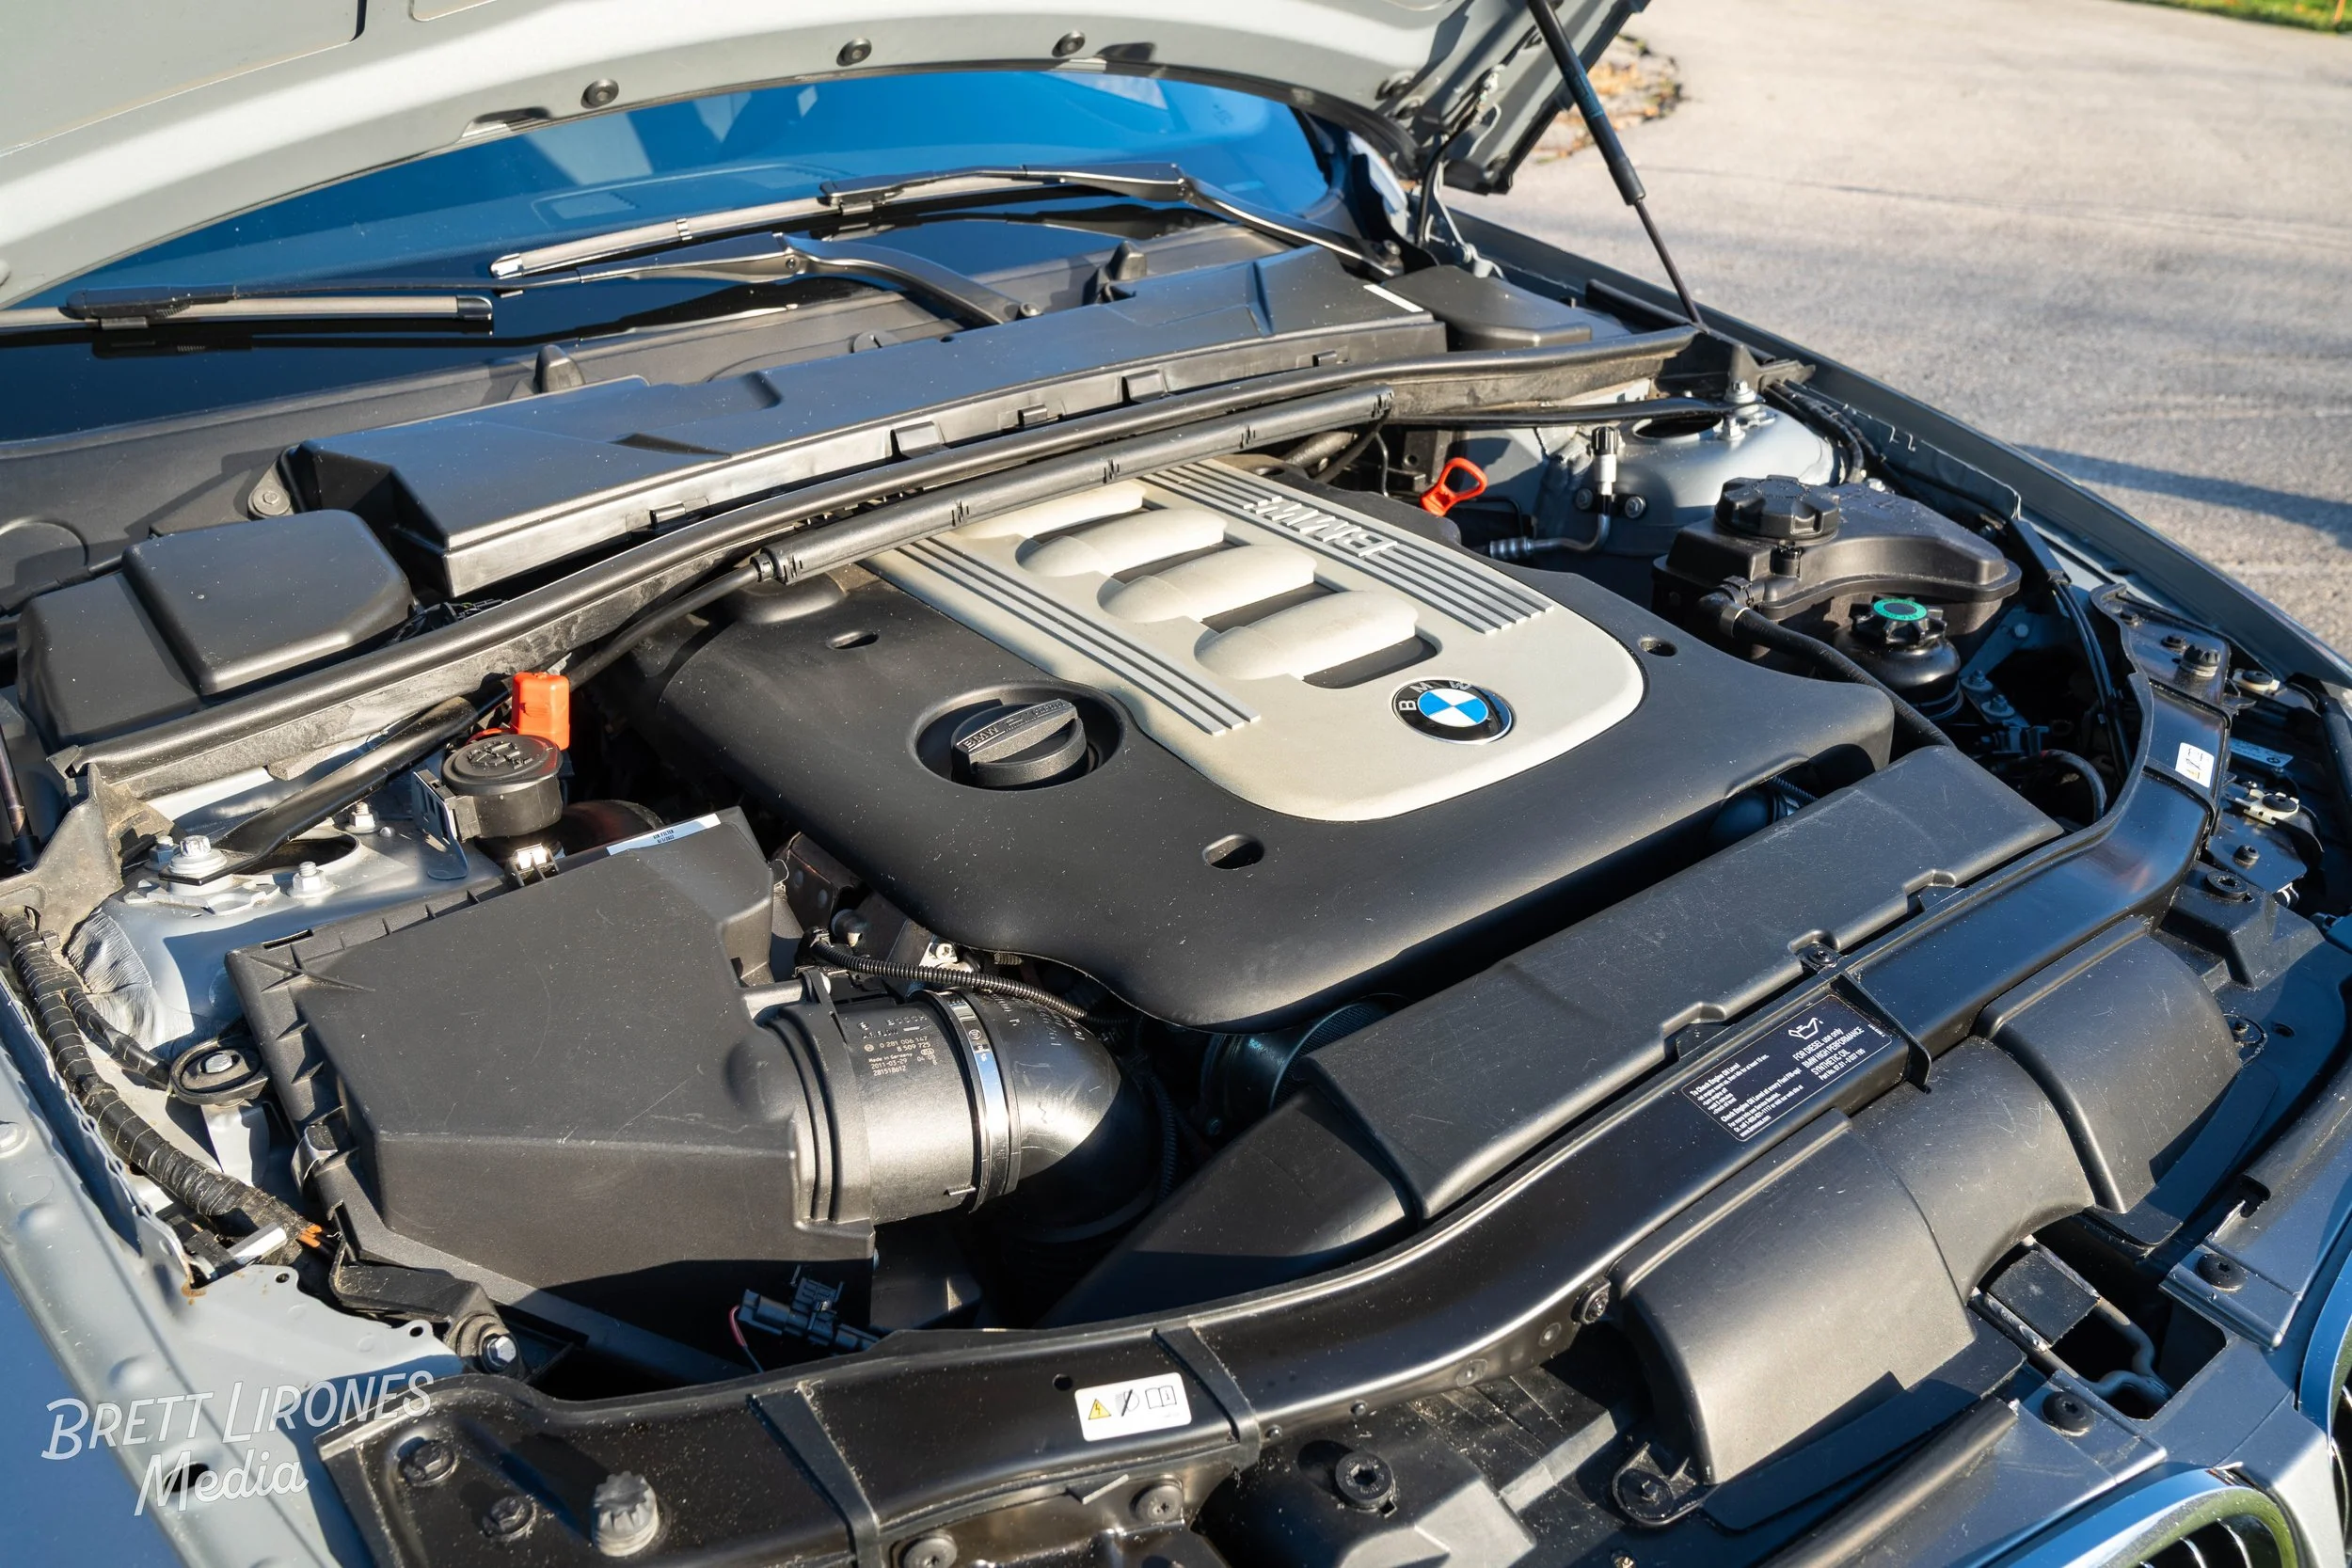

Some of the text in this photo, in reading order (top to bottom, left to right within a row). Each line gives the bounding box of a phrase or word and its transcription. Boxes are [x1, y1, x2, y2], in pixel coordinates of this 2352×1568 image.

[1249, 502, 1398, 557] BMW
[1398, 680, 1471, 711] BMW
[963, 725, 999, 749] BMW
[876, 1028, 898, 1037] FLOW
[885, 1016, 928, 1026] BOSCH
[1792, 1050, 1806, 1060] FOR
[1803, 1039, 1823, 1053] DIESEL
[1829, 1027, 1844, 1037] only
[1802, 1056, 1818, 1068] BMW
[1814, 1048, 1830, 1059] HIGH
[1826, 1026, 1864, 1052] PERFORMANCE
[871, 1058, 907, 1069] 2011-03-29
[1810, 1048, 1850, 1074] SYNTHETIC OIL
[1695, 1082, 1710, 1091] Check
[1708, 1073, 1724, 1085] Engine
[1726, 1063, 1740, 1071] Level
[1702, 1088, 1715, 1097] engine
[1720, 1111, 1735, 1121] Check
[1732, 1101, 1750, 1114] Engine
[1752, 1091, 1765, 1100] Level
[1768, 1082, 1781, 1091] every
